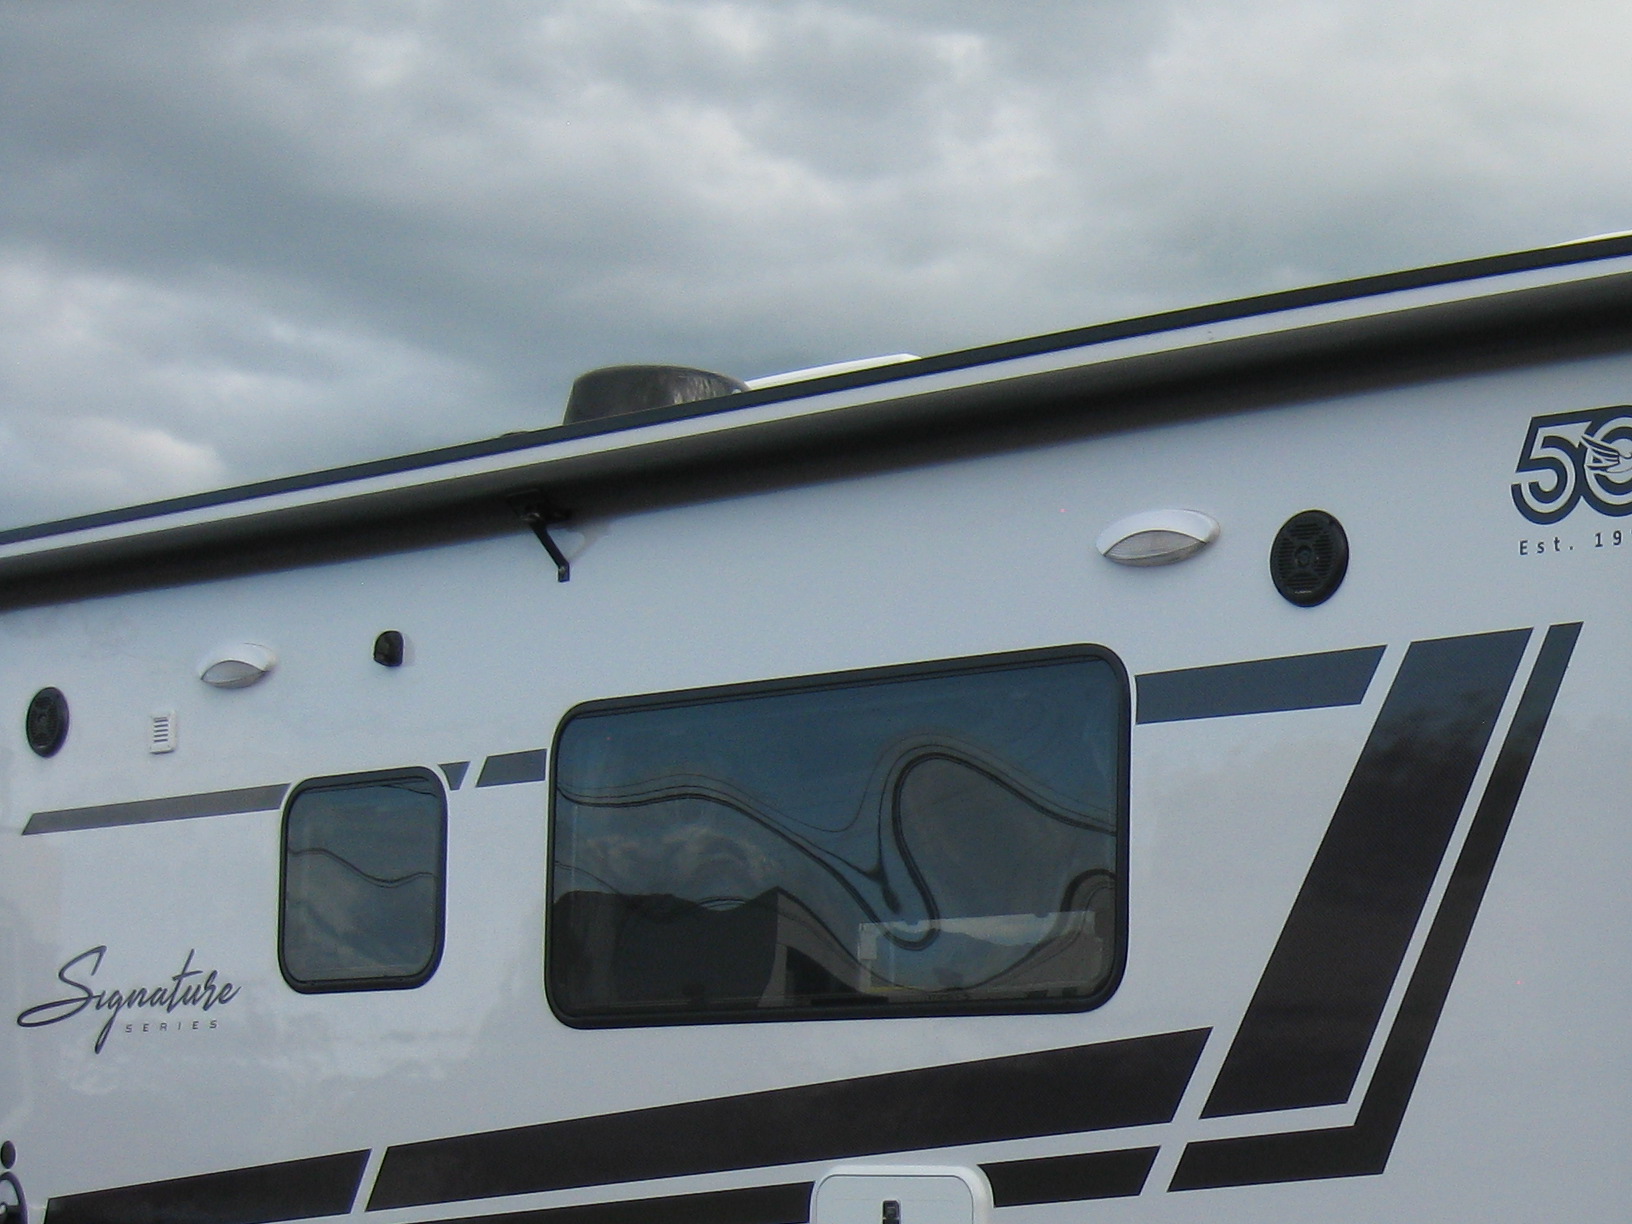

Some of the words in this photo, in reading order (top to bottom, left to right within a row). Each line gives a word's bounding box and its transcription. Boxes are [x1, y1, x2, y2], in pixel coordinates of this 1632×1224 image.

[1519, 536, 1574, 556] Est.
[16, 945, 242, 1054] Signature
[124, 1019, 219, 1033] SERIES
